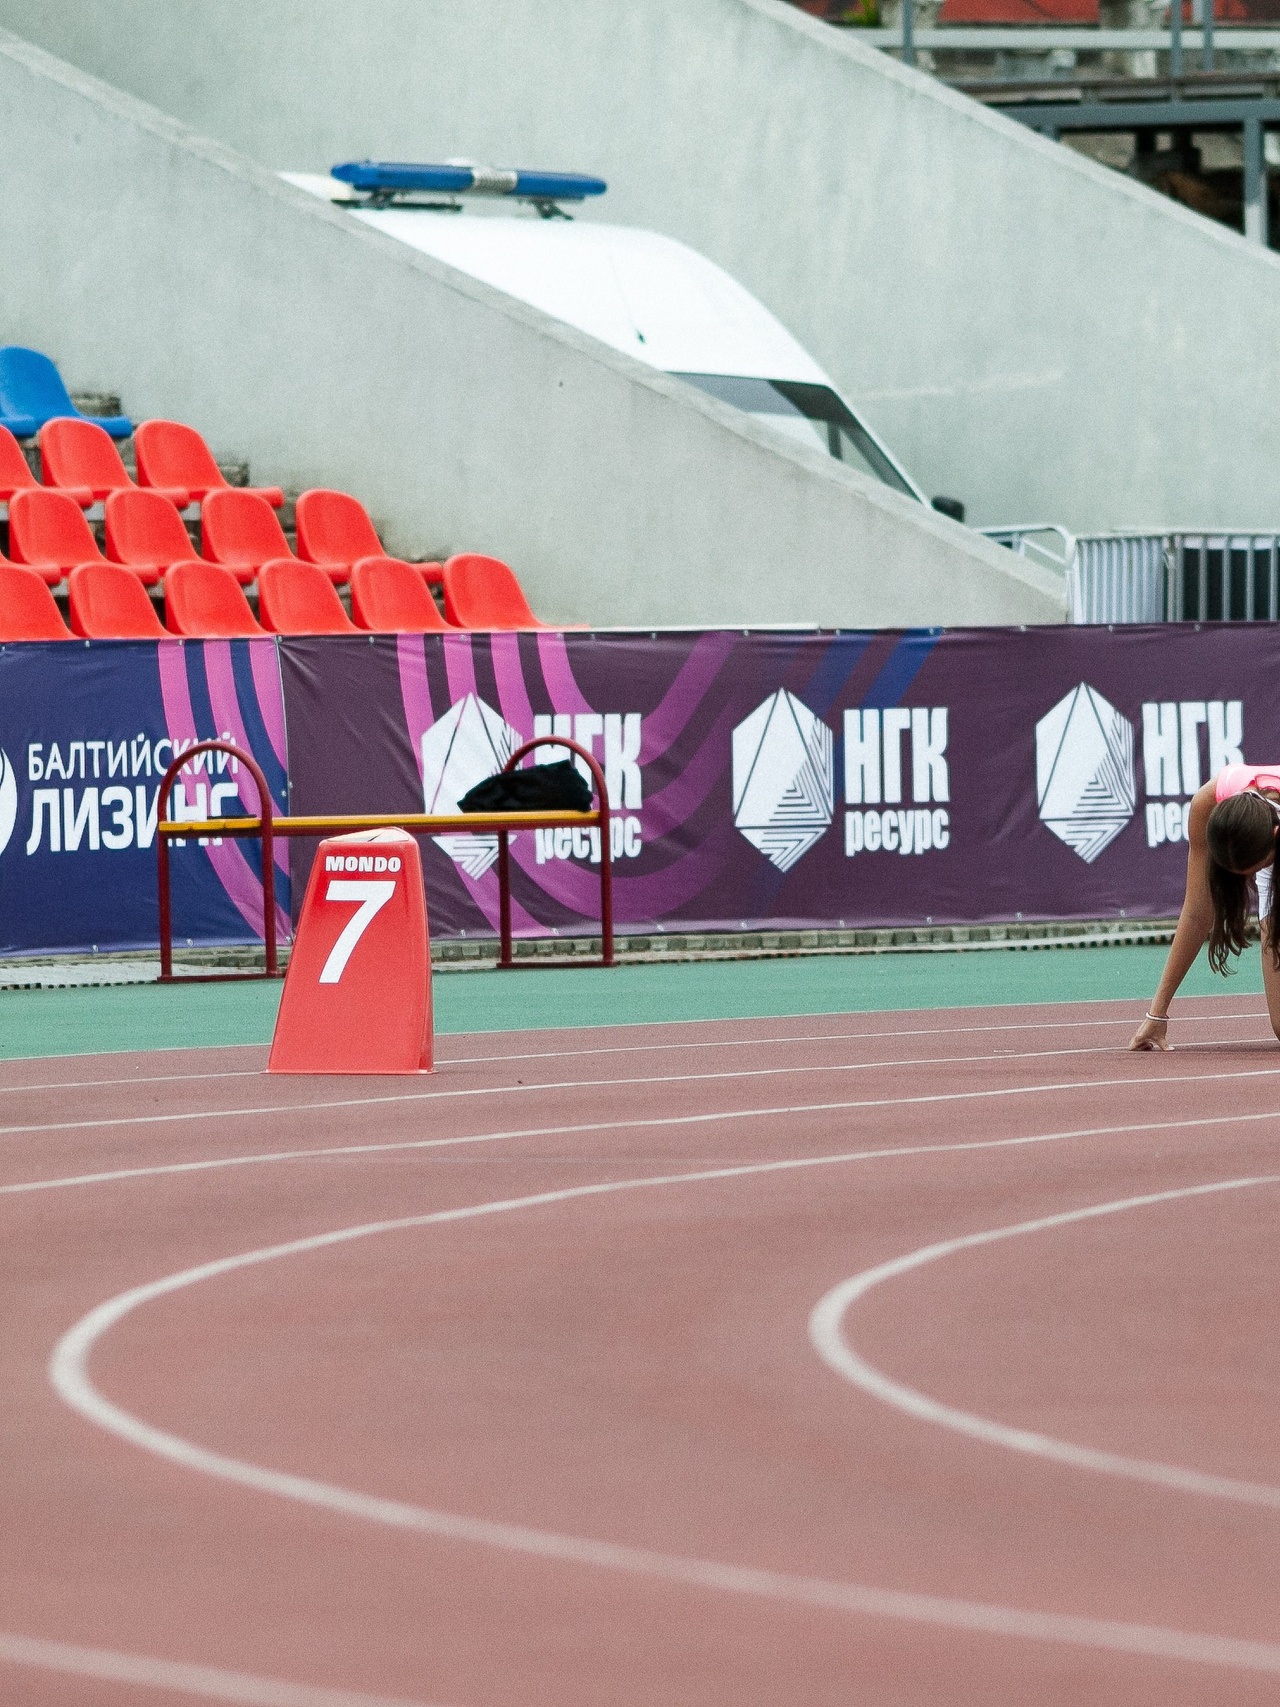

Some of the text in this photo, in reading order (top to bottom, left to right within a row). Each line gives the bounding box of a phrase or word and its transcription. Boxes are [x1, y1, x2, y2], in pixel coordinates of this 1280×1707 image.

[28, 732, 239, 781] БАЛТИЙСКИЙ
[844, 707, 950, 804] НГК
[1142, 701, 1245, 796] НГК
[26, 782, 239, 856] ЛИЗИНГ
[845, 808, 950, 857] ресурс
[325, 856, 401, 873] MONDO
[319, 880, 397, 984] 7
